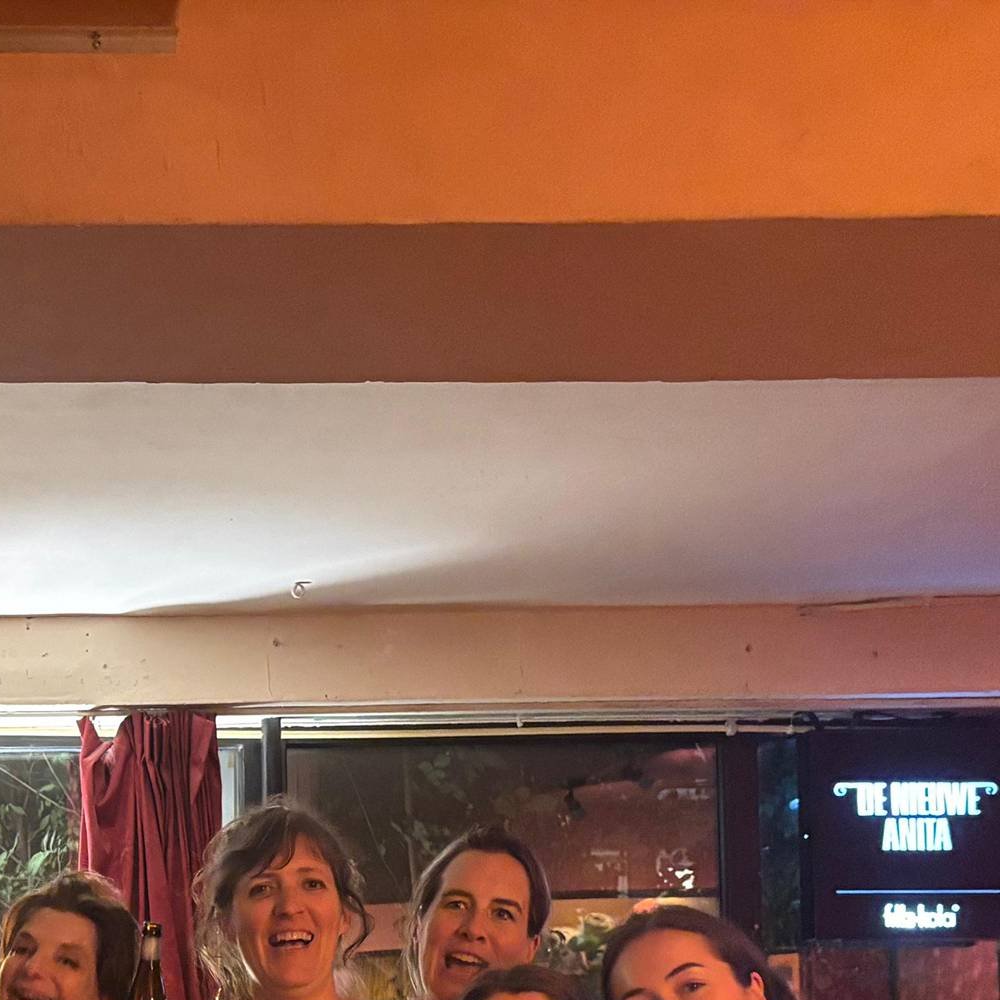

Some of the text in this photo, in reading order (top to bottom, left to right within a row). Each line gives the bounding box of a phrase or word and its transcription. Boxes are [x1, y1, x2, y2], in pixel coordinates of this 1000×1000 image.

[833, 782, 998, 816] DE NIEUWE
[881, 818, 953, 851] ANITA
